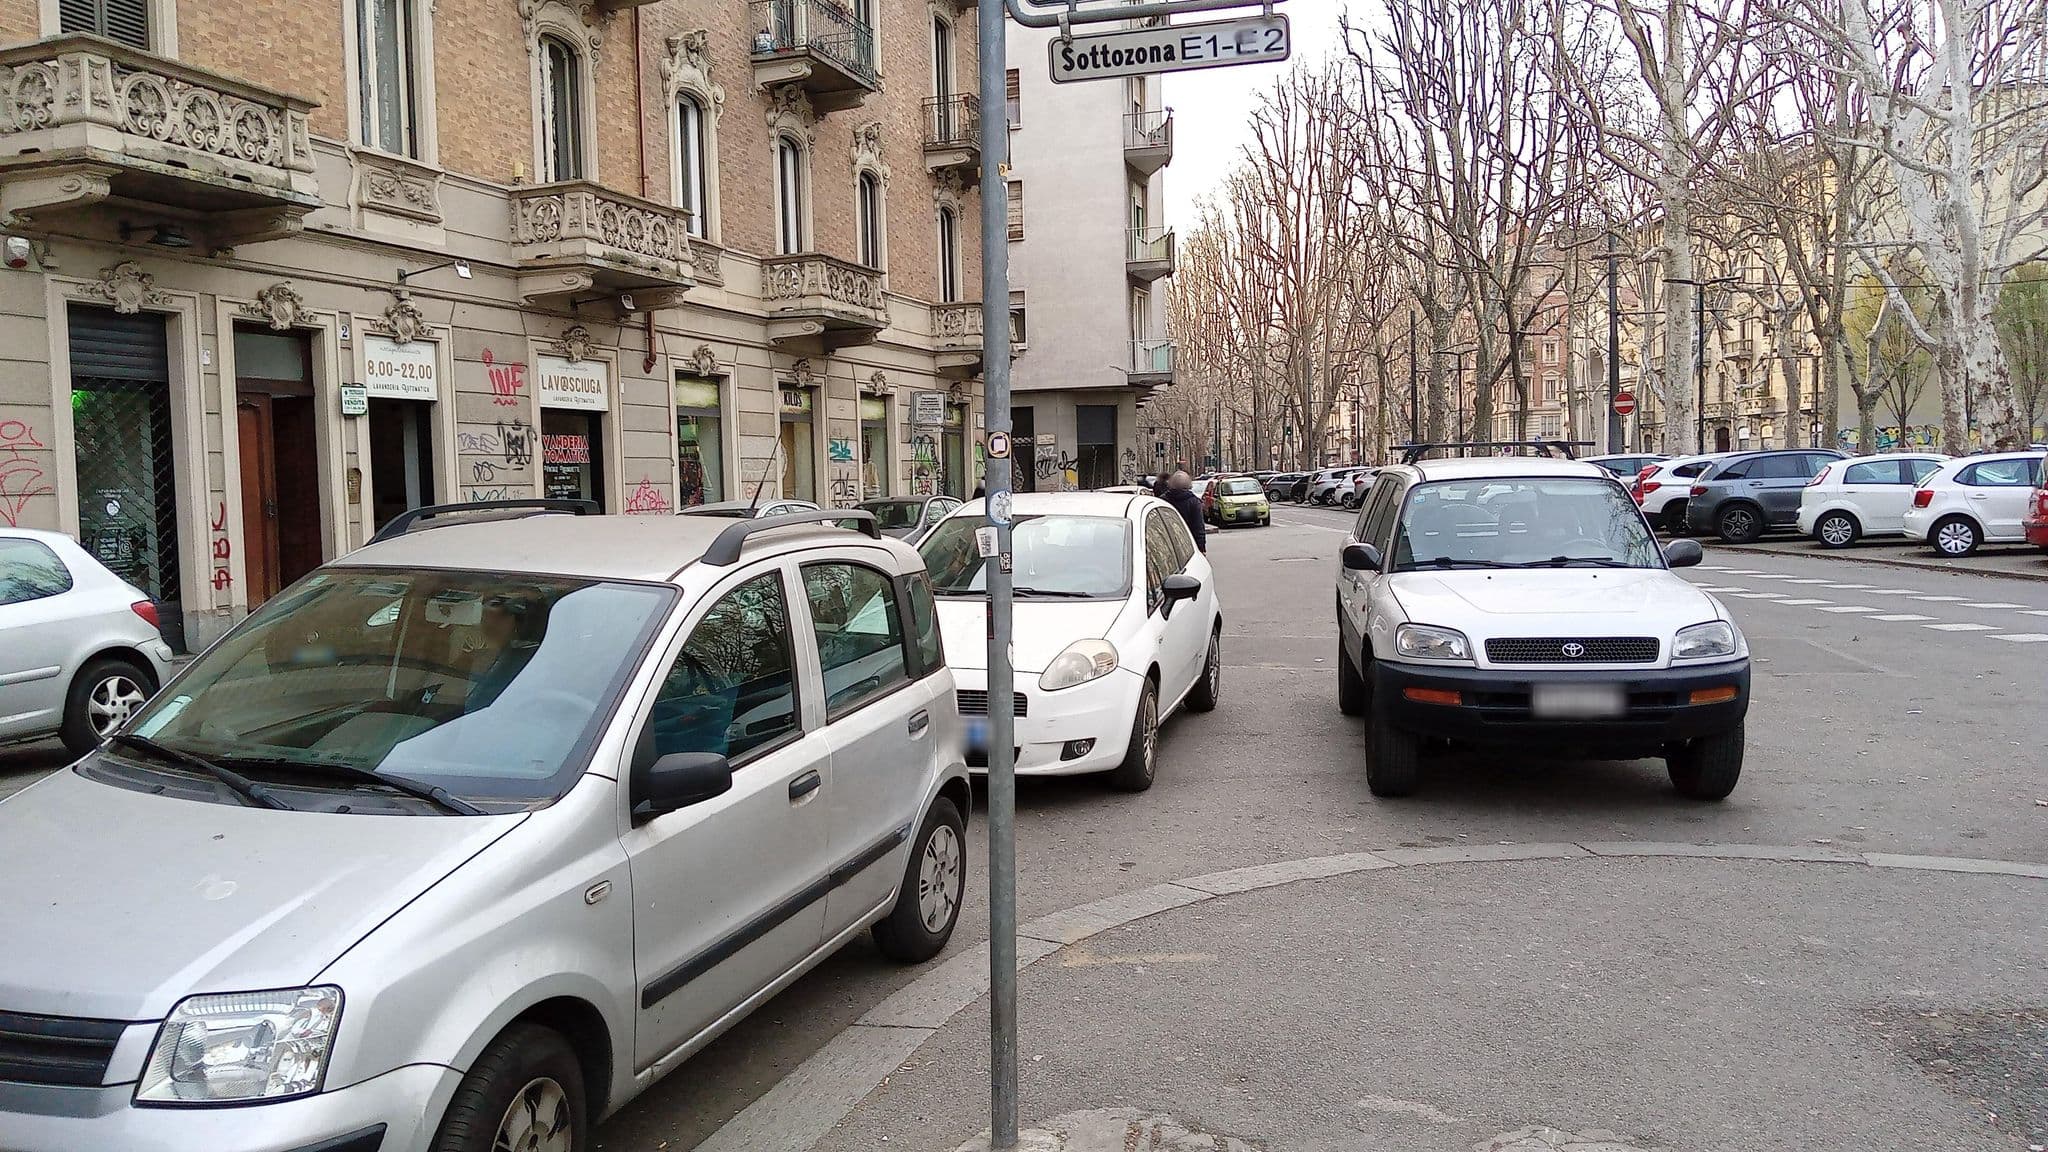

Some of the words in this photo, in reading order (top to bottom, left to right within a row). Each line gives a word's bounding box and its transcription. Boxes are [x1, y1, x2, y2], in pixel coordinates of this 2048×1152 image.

[1061, 43, 1176, 72] Sottozona
[341, 325, 348, 338] 2
[367, 359, 432, 380] 8,00-22,00
[372, 383, 400, 391] LAVANDERIA
[540, 373, 602, 394] LAV@SCIUGA
[542, 434, 589, 450] VANDERIA
[543, 448, 591, 464] TOMATICA
